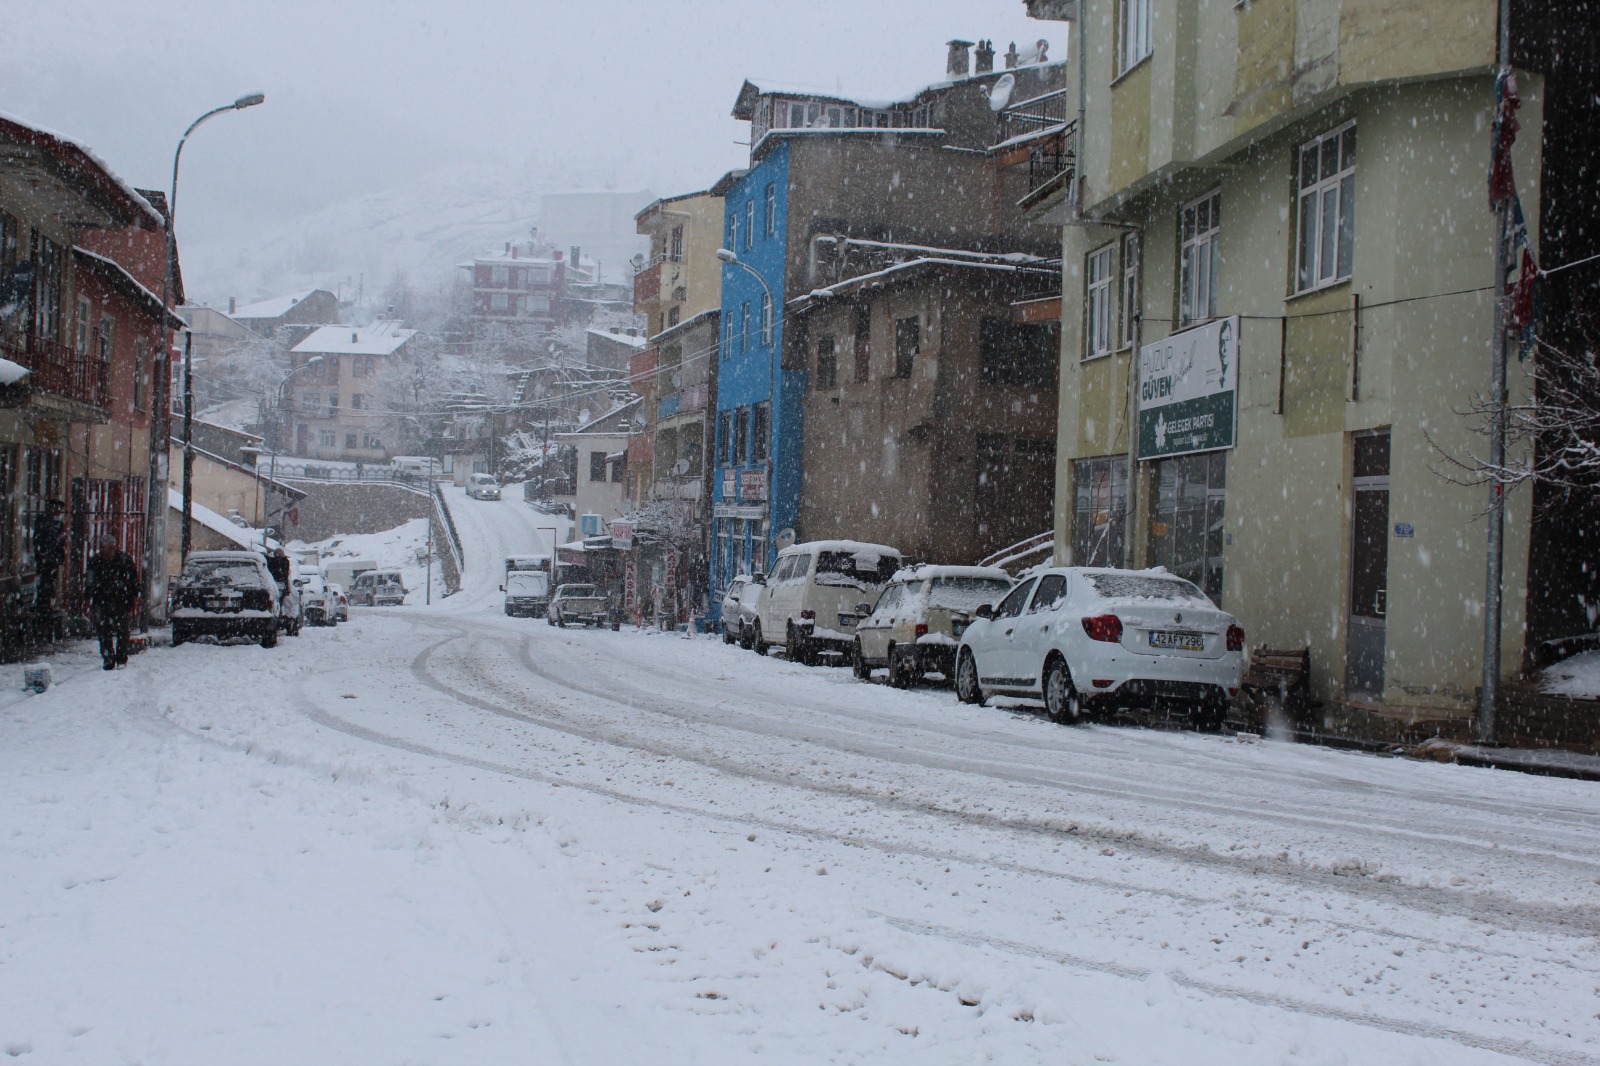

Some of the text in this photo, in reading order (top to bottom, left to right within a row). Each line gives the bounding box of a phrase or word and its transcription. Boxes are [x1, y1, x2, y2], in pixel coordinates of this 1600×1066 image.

[1142, 375, 1171, 401] GÜVEN
[1167, 417, 1192, 434] GELECEK
[626, 563, 635, 606] KASAP
[1155, 635, 1202, 647] 42 AFY 296
